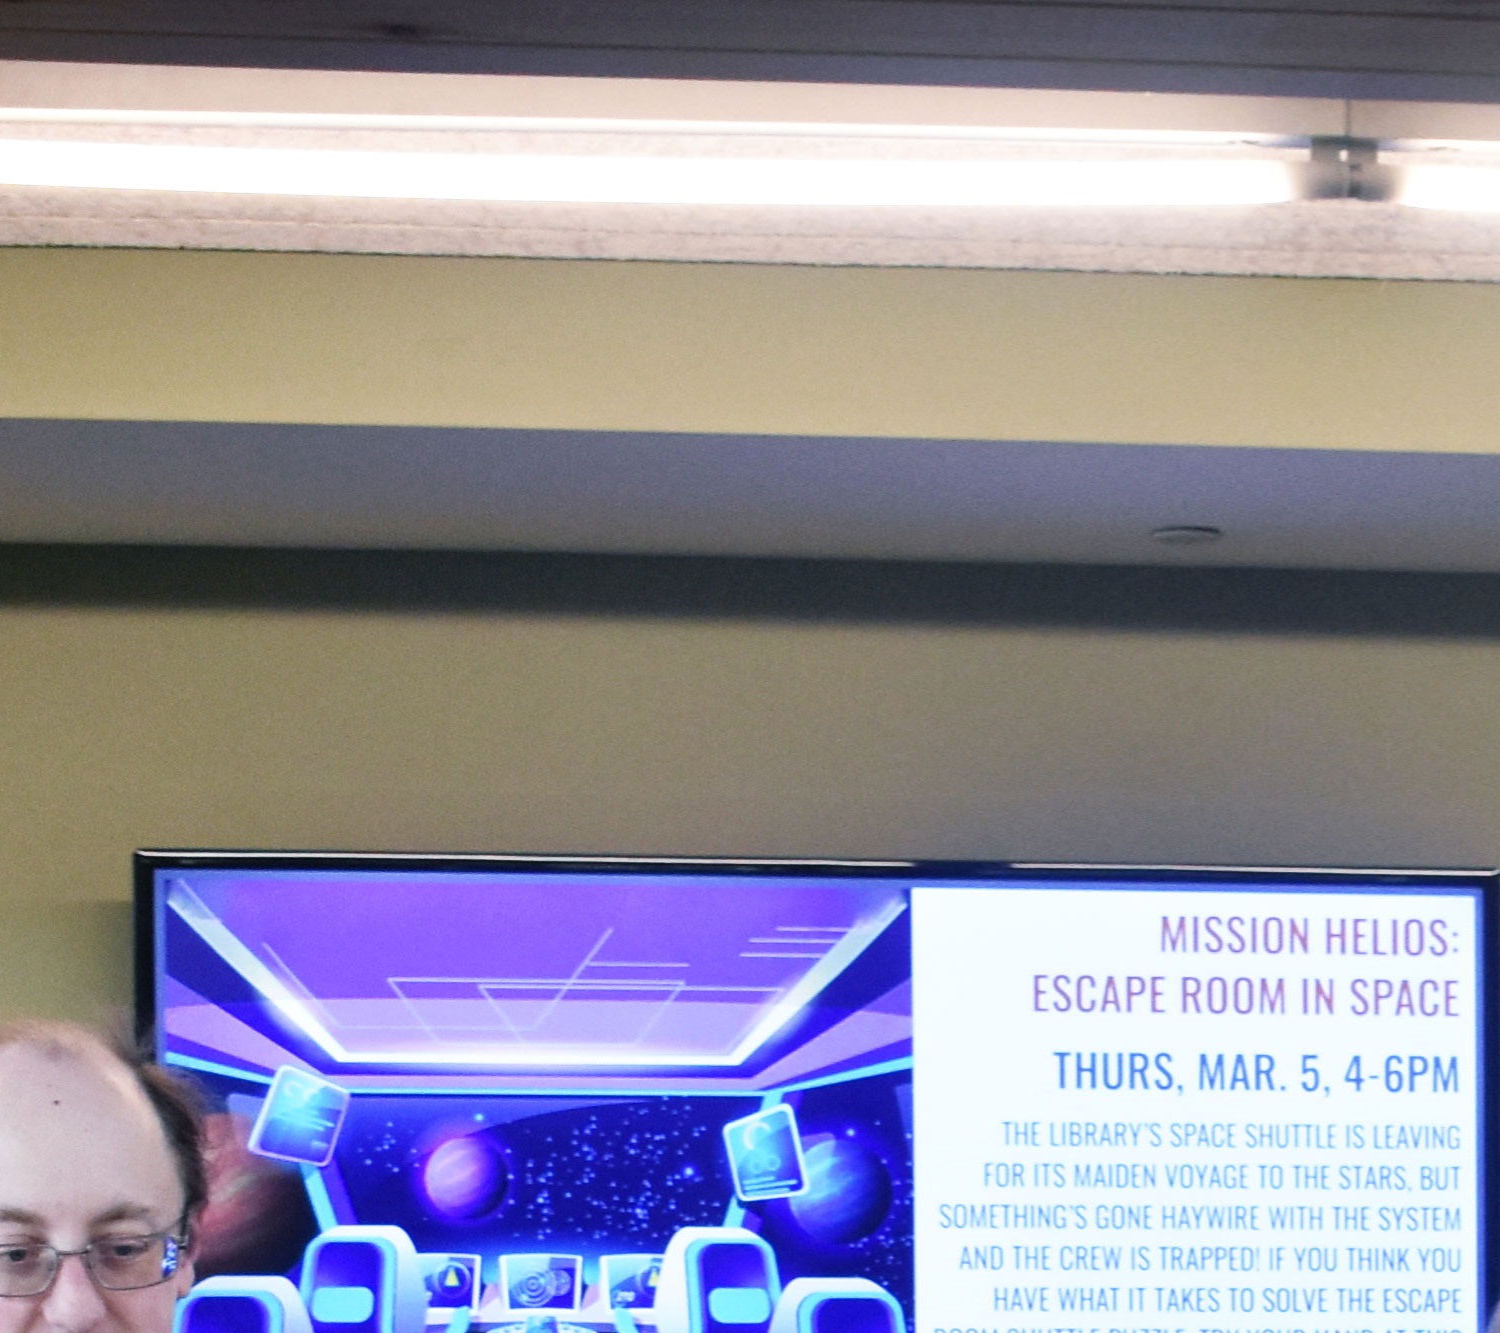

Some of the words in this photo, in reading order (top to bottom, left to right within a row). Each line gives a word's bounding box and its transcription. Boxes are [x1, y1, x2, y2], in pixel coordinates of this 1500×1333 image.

[1161, 915, 1309, 955] MISSION
[1325, 918, 1458, 957] HELIOS:
[1033, 974, 1166, 1014] ESCAPE
[1181, 976, 1285, 1015] ROOM
[1302, 978, 1334, 1016] IN
[1350, 978, 1459, 1017] SPACE
[1052, 1051, 1184, 1096] THURS,
[1198, 1052, 1287, 1092] MAR.
[1300, 1054, 1331, 1098] 5,
[1343, 1054, 1459, 1094] 4-6PM
[1001, 1121, 1041, 1147] THE
[1170, 1122, 1236, 1148] SPACE
[1245, 1123, 1337, 1149] SHUTTLE
[1345, 1124, 1366, 1149] IS
[1373, 1124, 1461, 1150] LEAVING
[983, 1162, 1026, 1188] FOR
[1033, 1162, 1066, 1188] ITS
[1073, 1163, 1156, 1189] MAIDEN
[1164, 1163, 1249, 1190] VOYAGE
[1258, 1164, 1284, 1190] TO
[1292, 1164, 1331, 1190] THE
[1338, 1165, 1412, 1193] STARS,
[1420, 1165, 1460, 1191] BUT
[1095, 1204, 1153, 1230] GONE
[1161, 1205, 1260, 1231] HAYWIRE
[1268, 1205, 1324, 1231] WITH
[1332, 1206, 1370, 1232] THE
[1378, 1206, 1461, 1232] SYSTEM
[958, 1245, 1004, 1271] AND
[1012, 1245, 1051, 1271] THE
[1059, 1245, 1122, 1271] CREW
[1130, 1246, 1151, 1271] IS
[1158, 1246, 1260, 1272] TRAPPED!
[1269, 1246, 1285, 1272] IF
[1293, 1246, 1338, 1272] YOU
[1346, 1247, 1411, 1272] THINK
[1417, 1247, 1462, 1273] YOU
[994, 1286, 1049, 1312] HAVE
[1057, 1287, 1120, 1312] WHAT
[1128, 1287, 1147, 1312] IT
[1154, 1287, 1220, 1313] TAKES
[1227, 1287, 1255, 1313] TO
[1262, 1287, 1328, 1313] SOLVE
[1336, 1288, 1375, 1313] THE
[1382, 1288, 1462, 1314] ESCAPE
